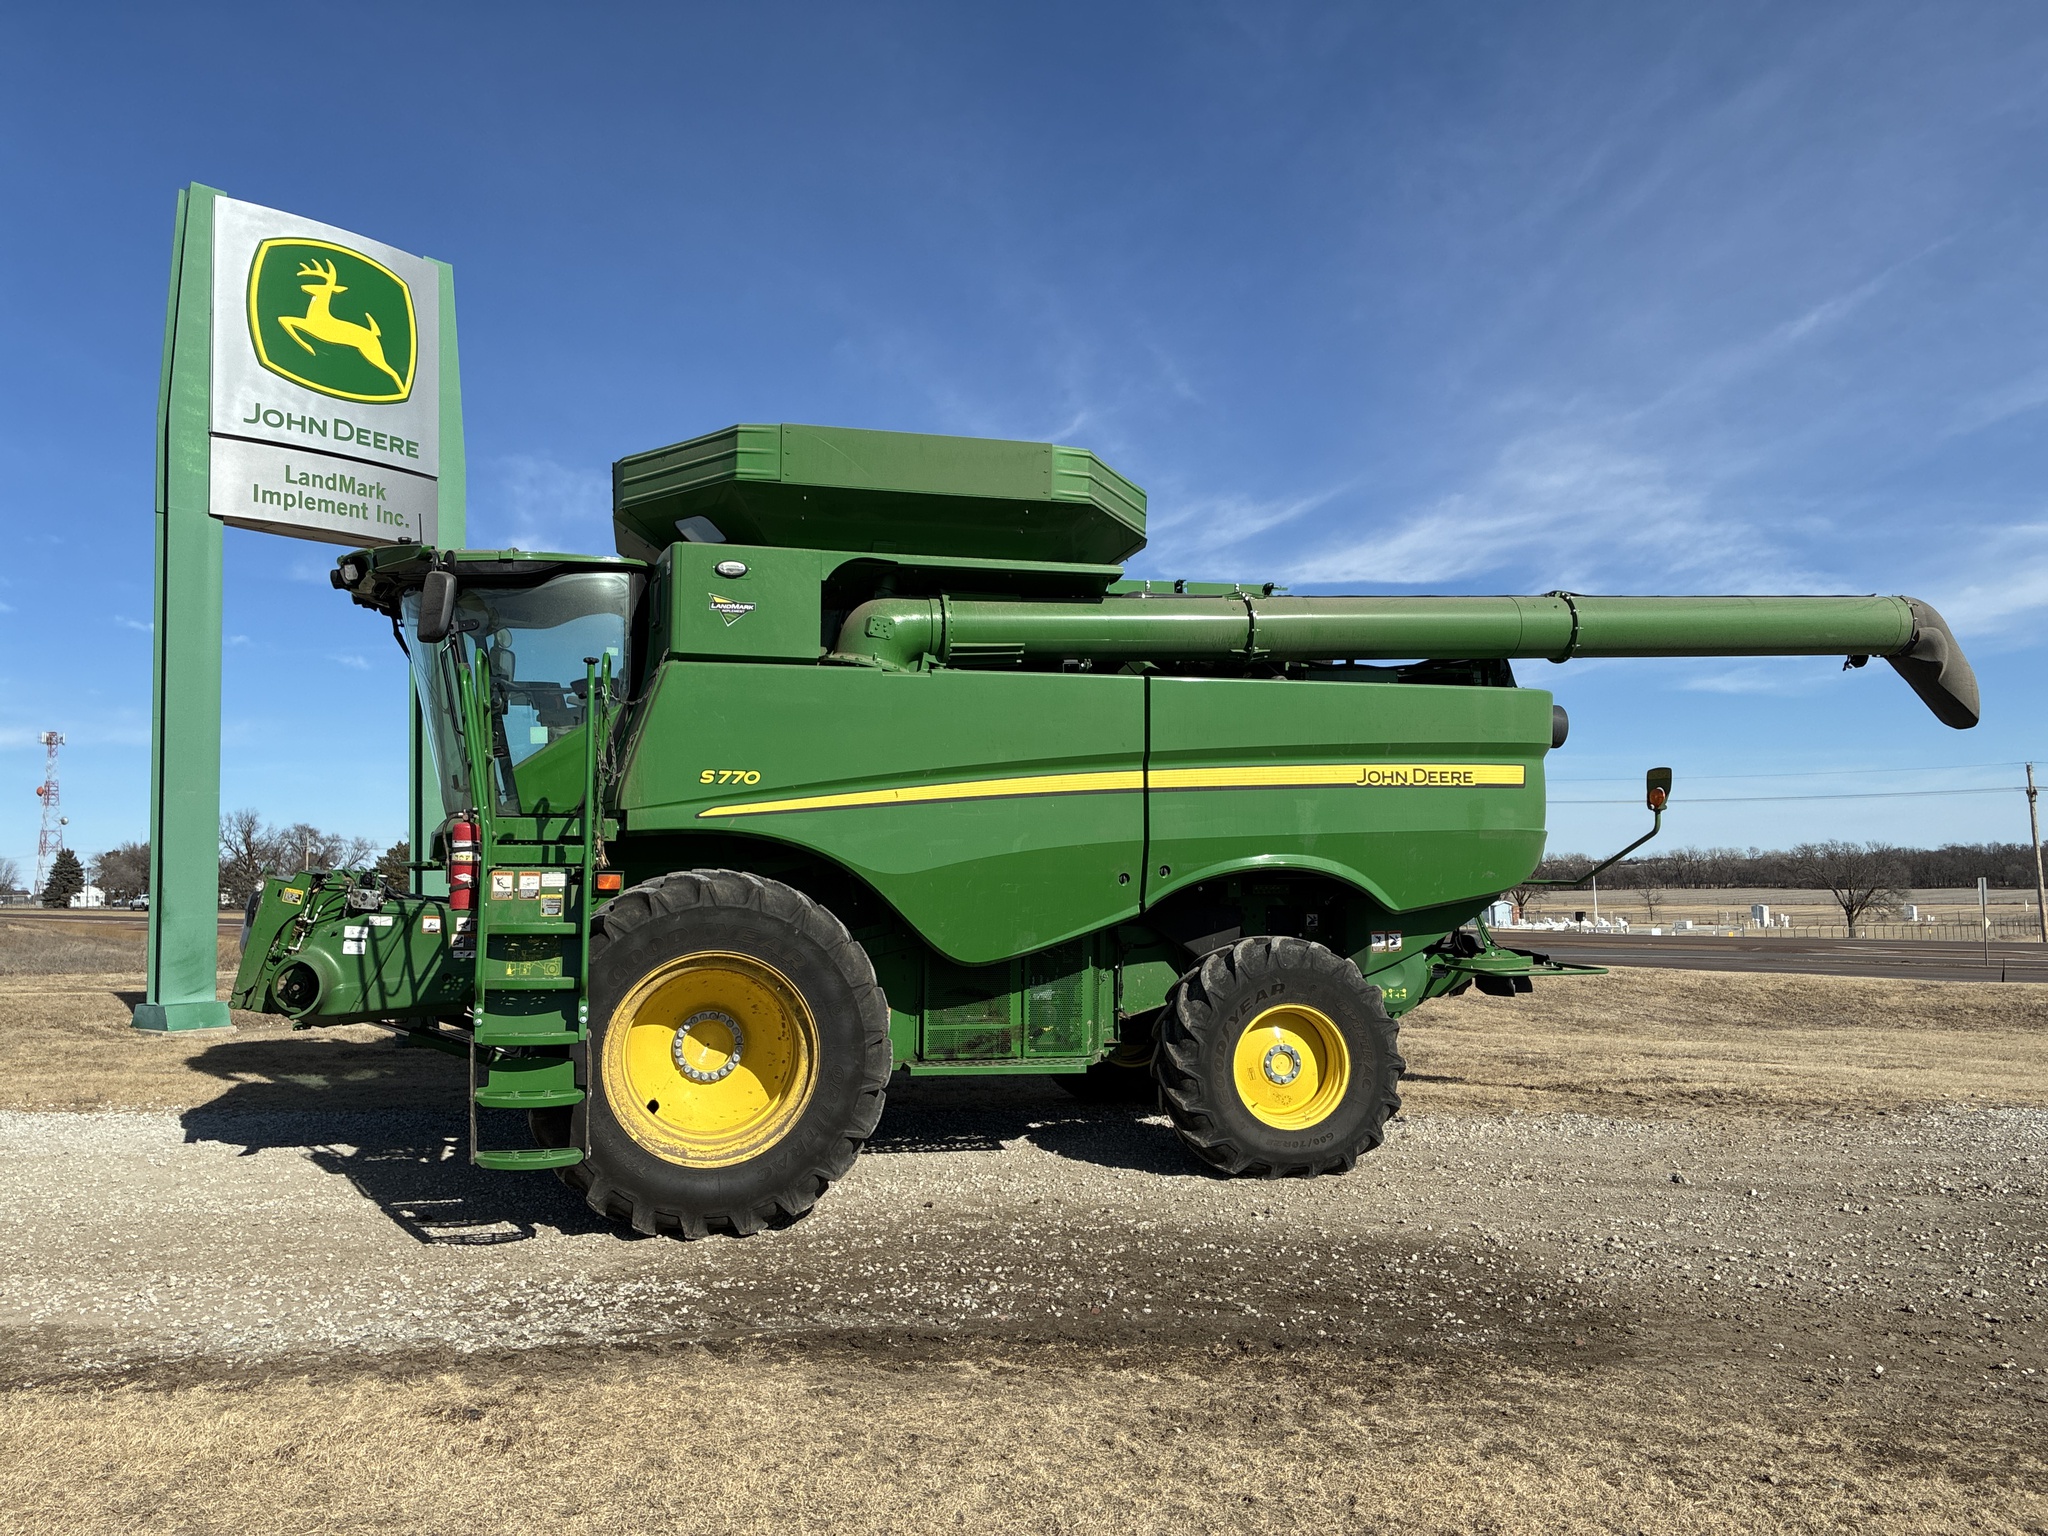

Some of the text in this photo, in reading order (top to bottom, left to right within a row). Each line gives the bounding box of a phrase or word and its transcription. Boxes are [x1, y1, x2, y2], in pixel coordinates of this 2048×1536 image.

[243, 402, 419, 459] JOHN DEERE
[285, 464, 386, 501] LandMark
[253, 483, 410, 528] Implement Inc.
[699, 769, 761, 785] S770
[1356, 768, 1474, 784] JOHN DEERE
[1212, 982, 1287, 1106] GOODYEAR
[1334, 998, 1375, 1092] OPTITRAC
